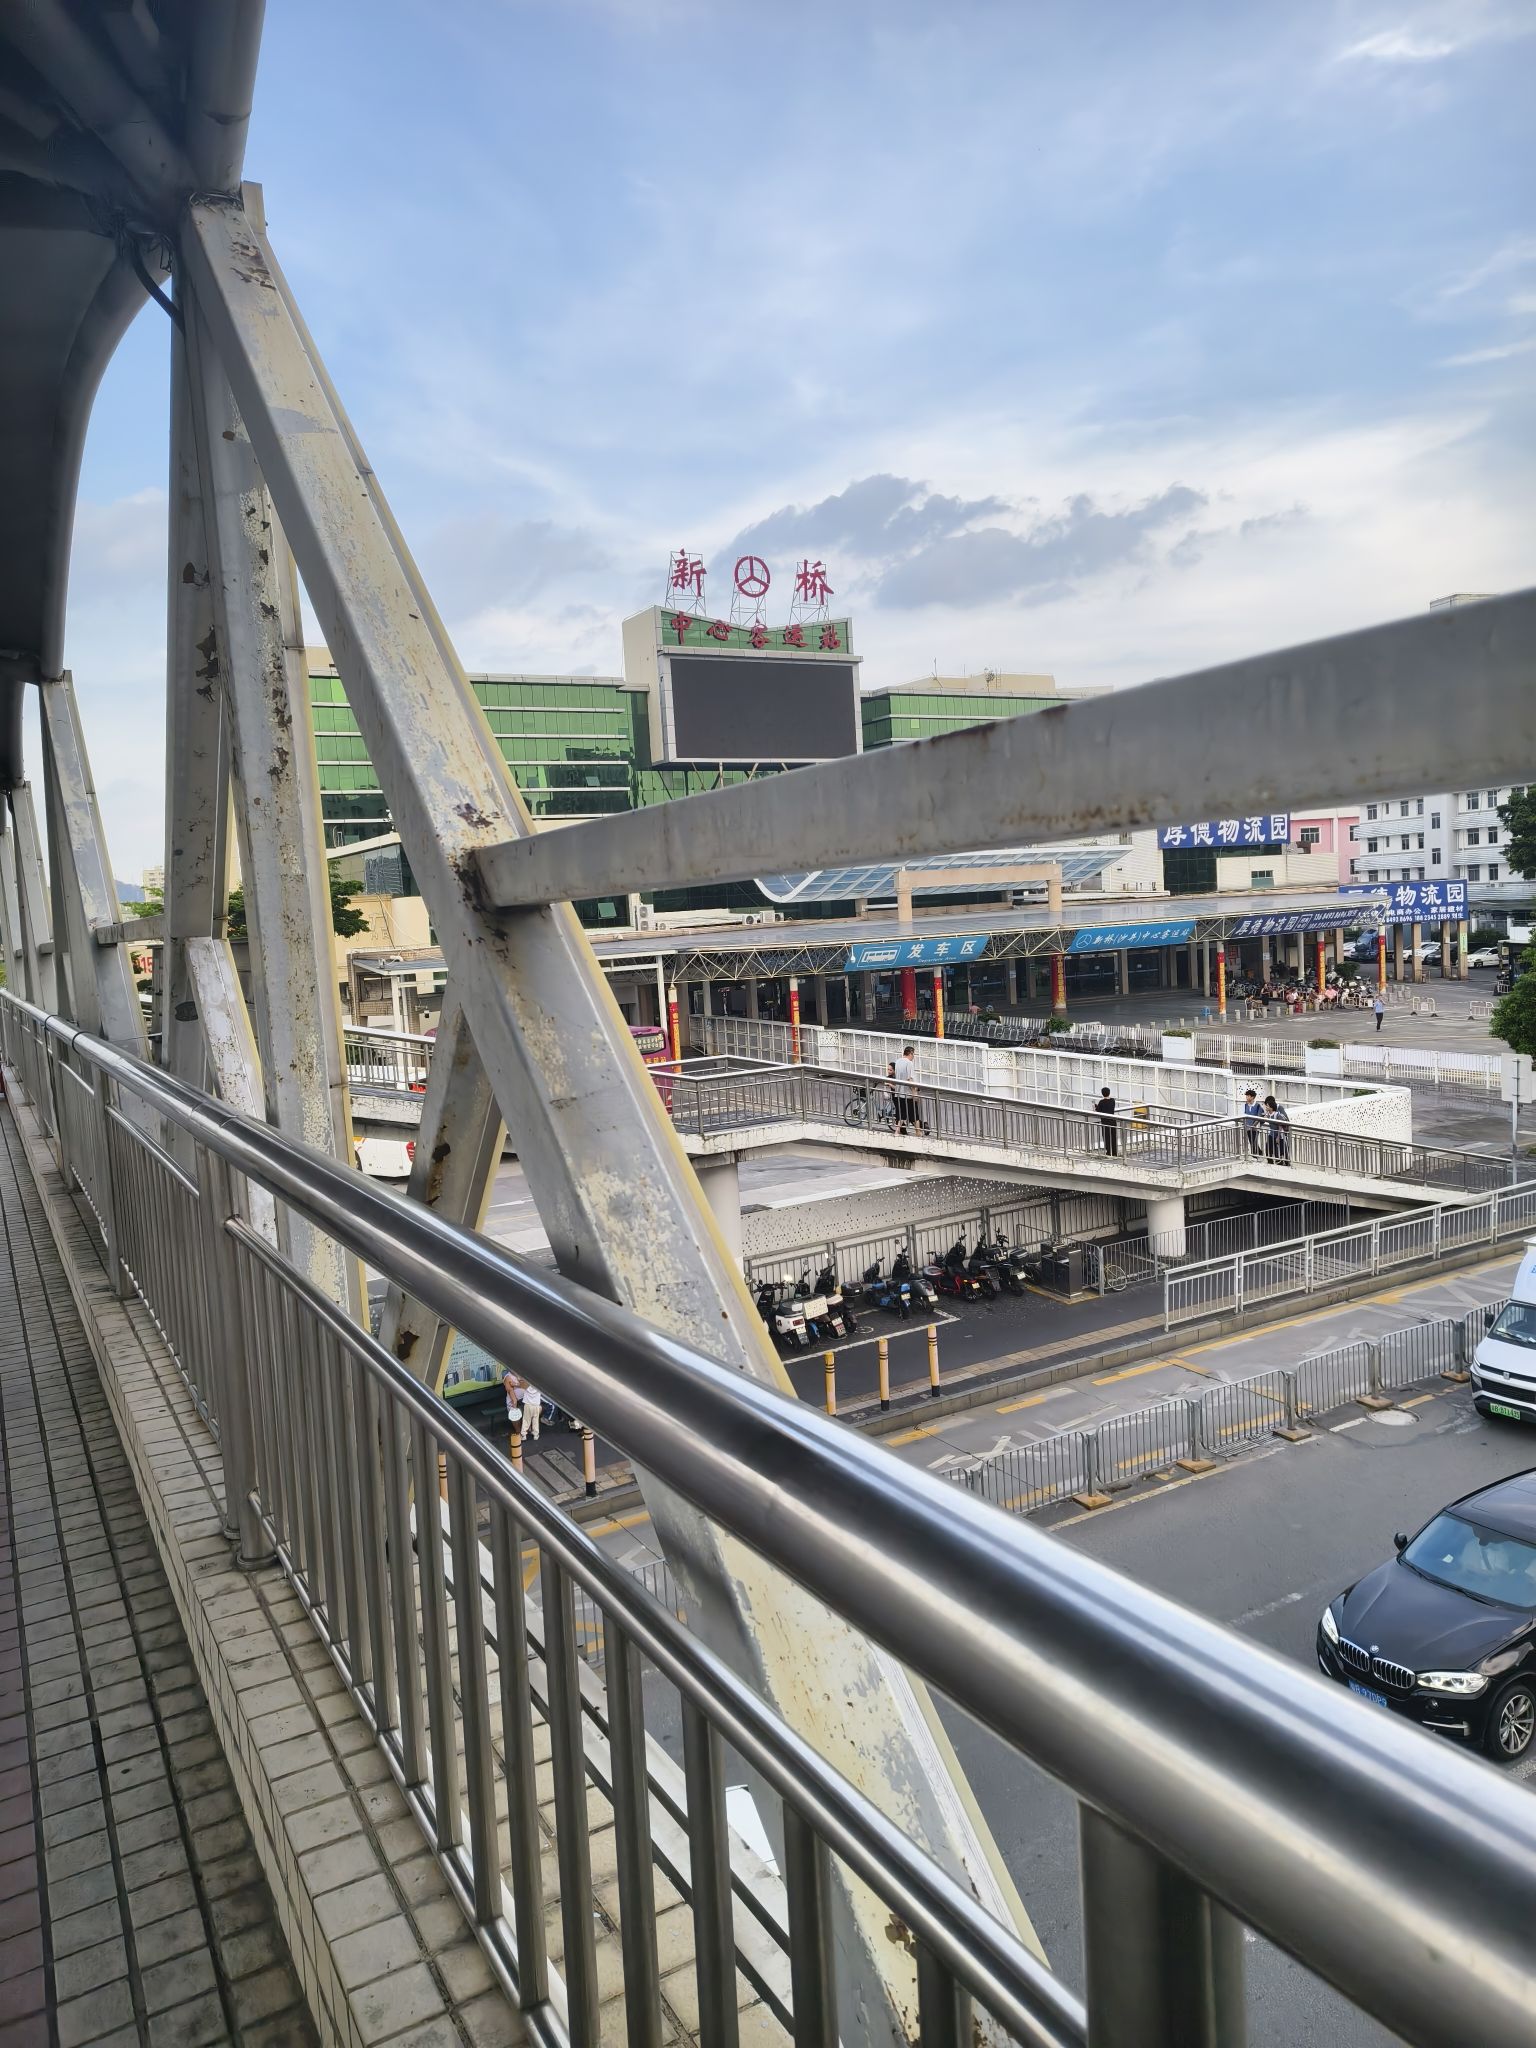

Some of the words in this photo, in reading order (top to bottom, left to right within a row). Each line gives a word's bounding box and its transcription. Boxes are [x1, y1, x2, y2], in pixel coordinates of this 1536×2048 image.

[671, 548, 707, 597] 新
[796, 559, 834, 605] 桥
[671, 611, 841, 649] 中心客运站
[1235, 916, 1299, 936] 厚德物流园
[907, 940, 977, 959] 发车区
